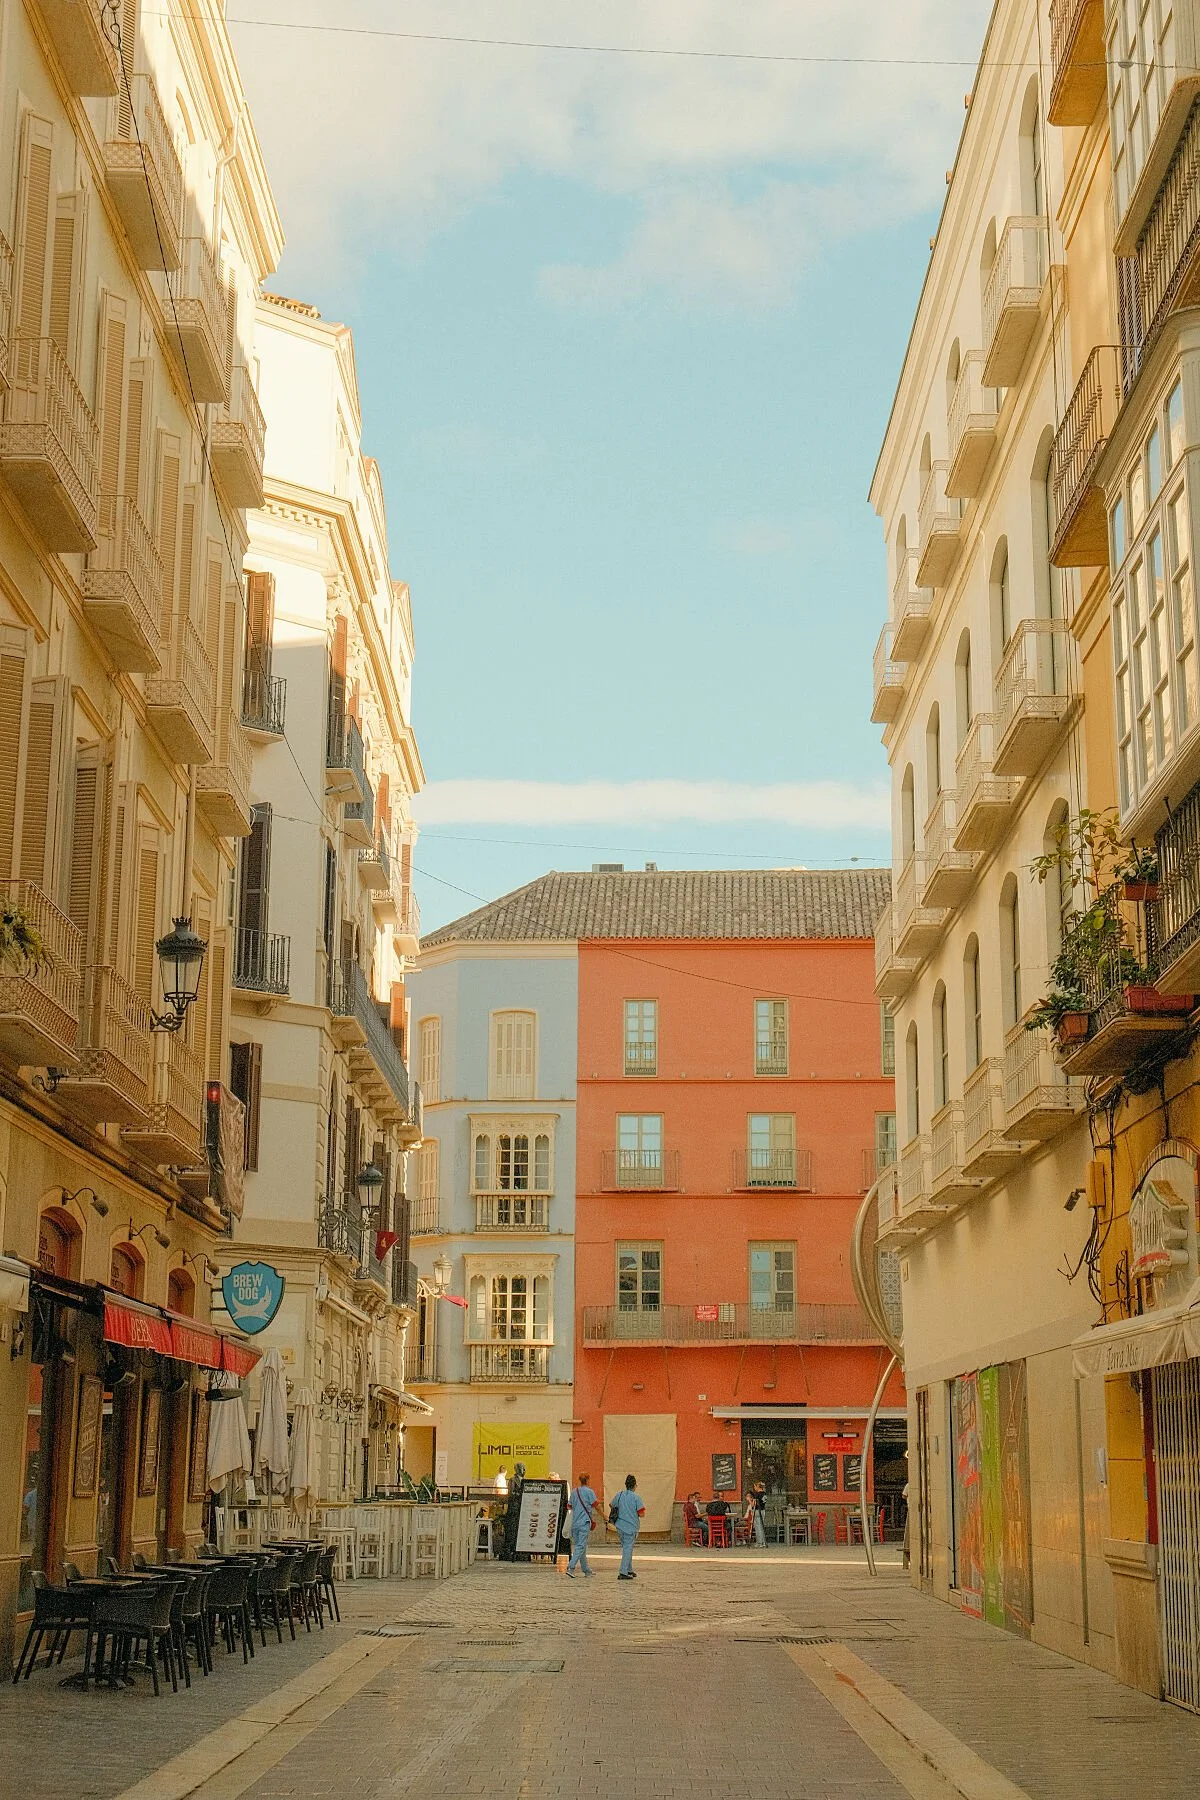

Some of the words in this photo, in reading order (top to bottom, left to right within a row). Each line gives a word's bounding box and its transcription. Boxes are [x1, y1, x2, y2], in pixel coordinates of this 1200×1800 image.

[233, 1273, 264, 1288] BREW
[238, 1287, 259, 1301] DOG
[478, 1445, 511, 1455] LIMO
